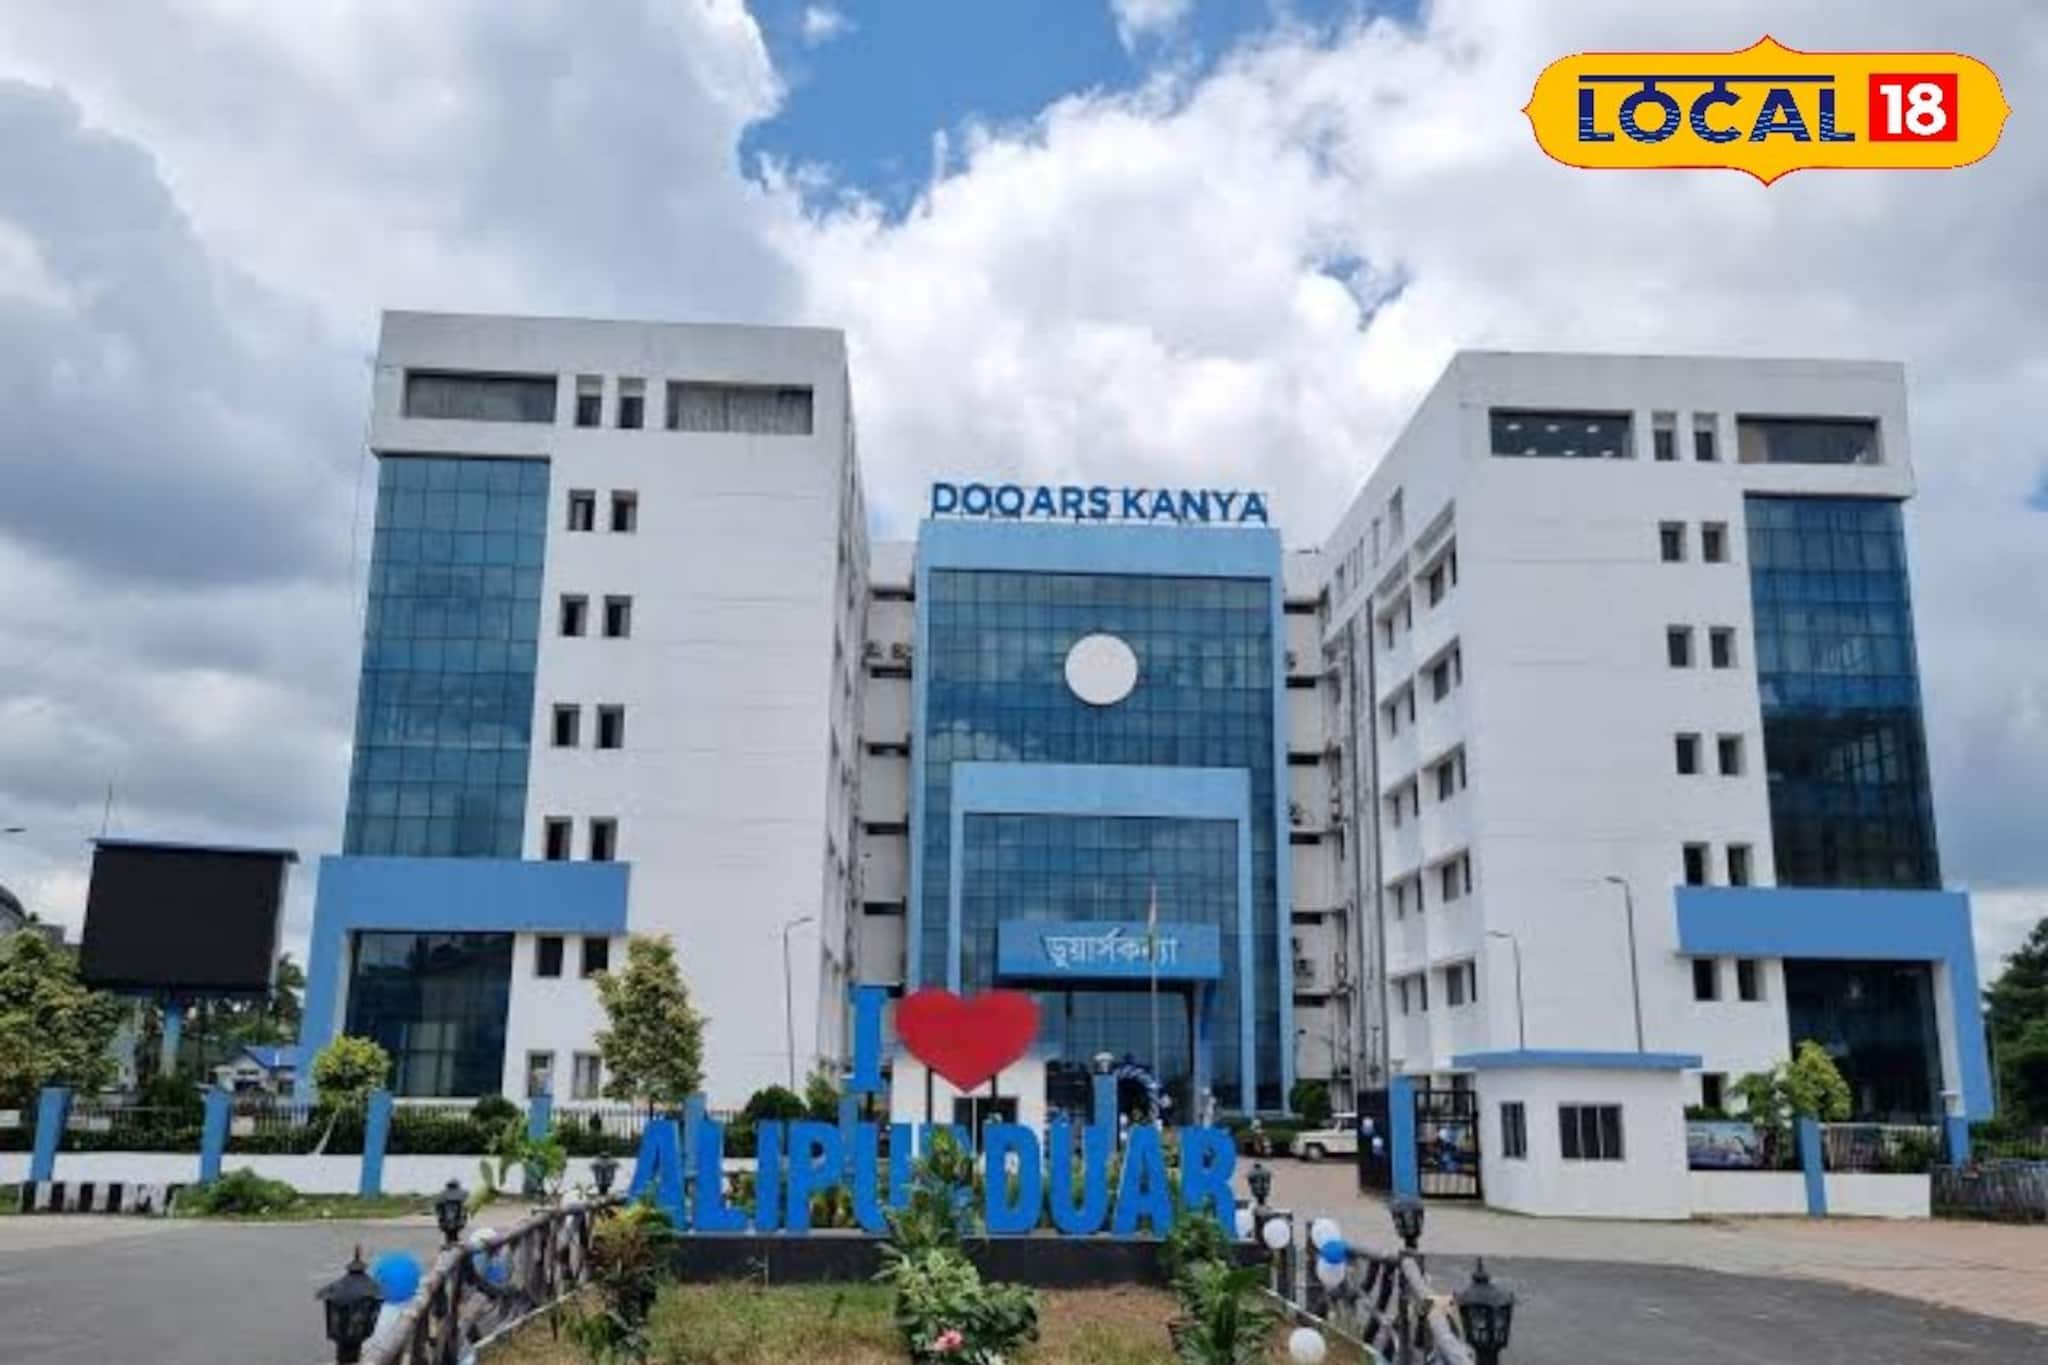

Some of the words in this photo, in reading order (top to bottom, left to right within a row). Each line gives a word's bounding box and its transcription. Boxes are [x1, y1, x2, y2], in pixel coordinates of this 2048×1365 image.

[932, 482, 1112, 520] DOOARS
[1121, 487, 1269, 523] KANYA
[848, 982, 889, 1095] I
[628, 1116, 1239, 1239] ALIPUDUAR
